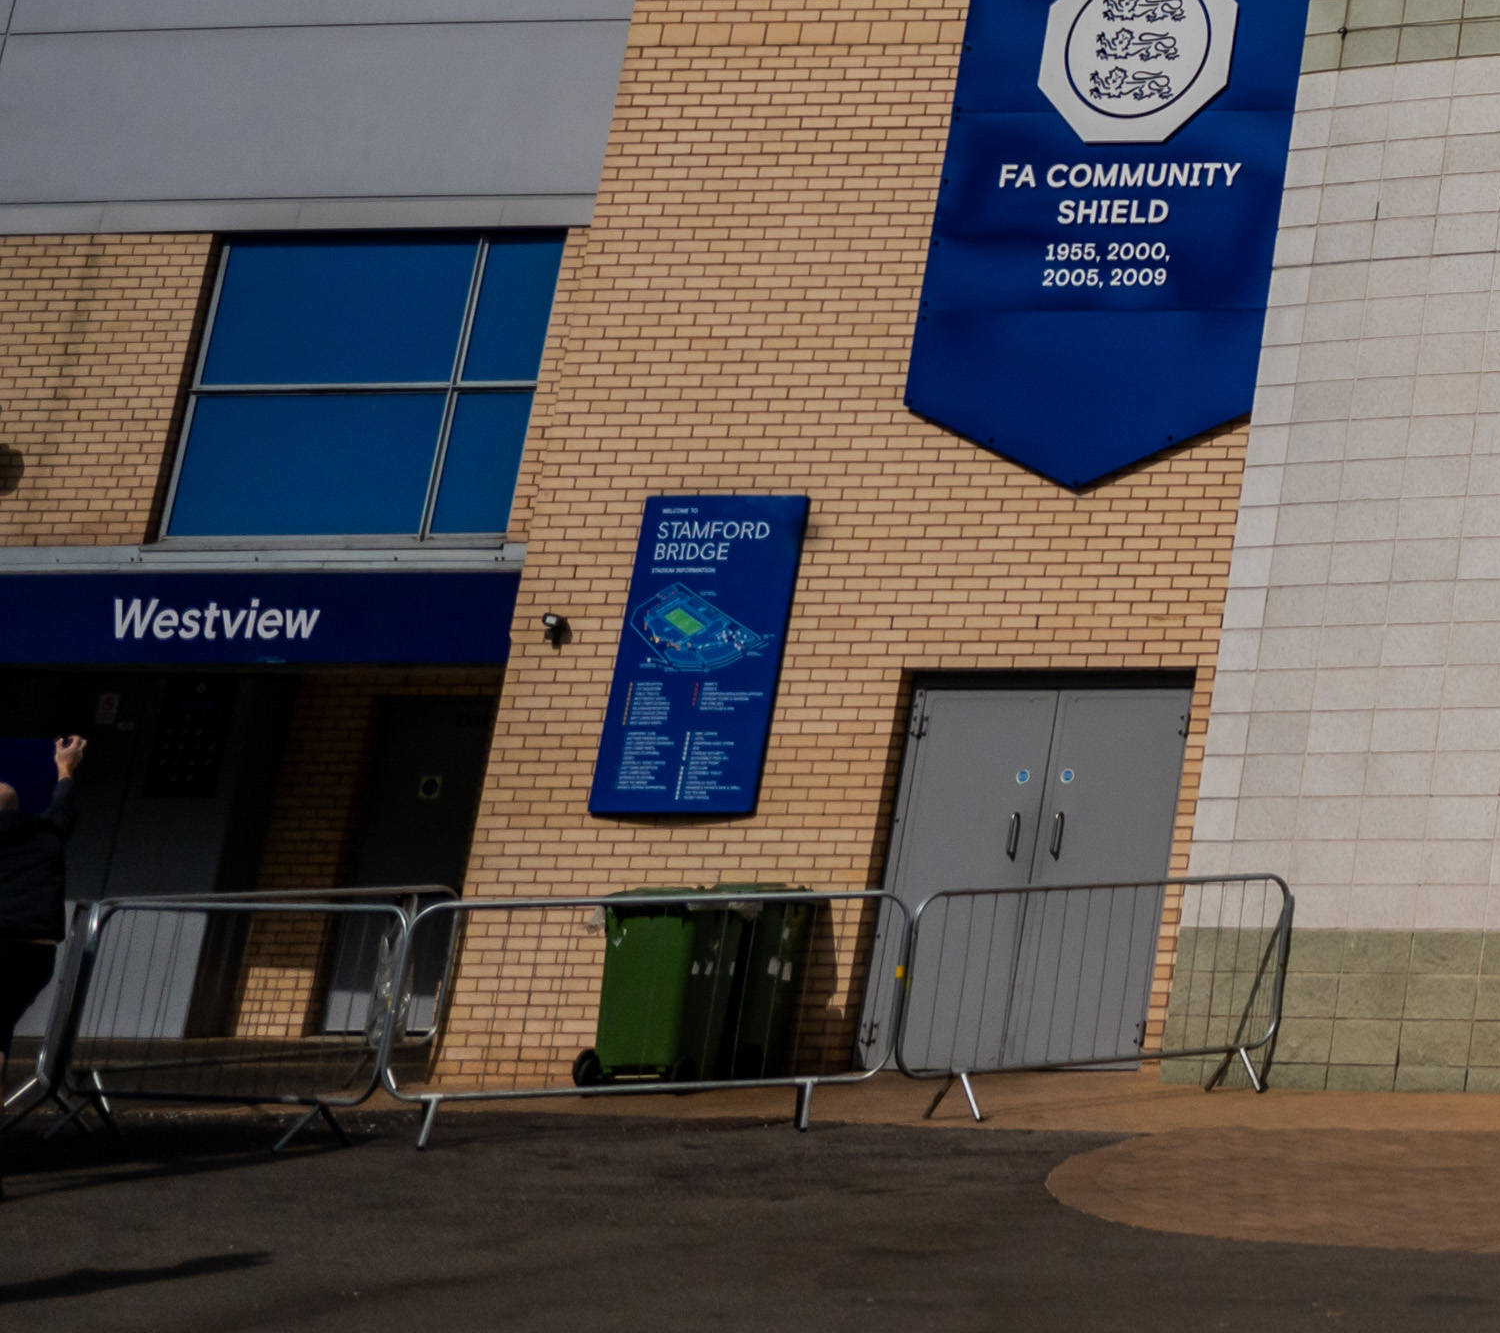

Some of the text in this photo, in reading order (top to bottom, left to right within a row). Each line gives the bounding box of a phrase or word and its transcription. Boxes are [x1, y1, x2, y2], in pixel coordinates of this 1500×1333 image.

[1000, 163, 1241, 187] FA COMMUNITY
[1058, 200, 1168, 224] SHIELD
[1046, 243, 1169, 261] 1955, 2000,
[1043, 268, 1166, 287] 2005, 2009
[657, 521, 771, 540] STAMFORD
[653, 542, 731, 562] BRIDGE
[114, 598, 321, 639] Westview
